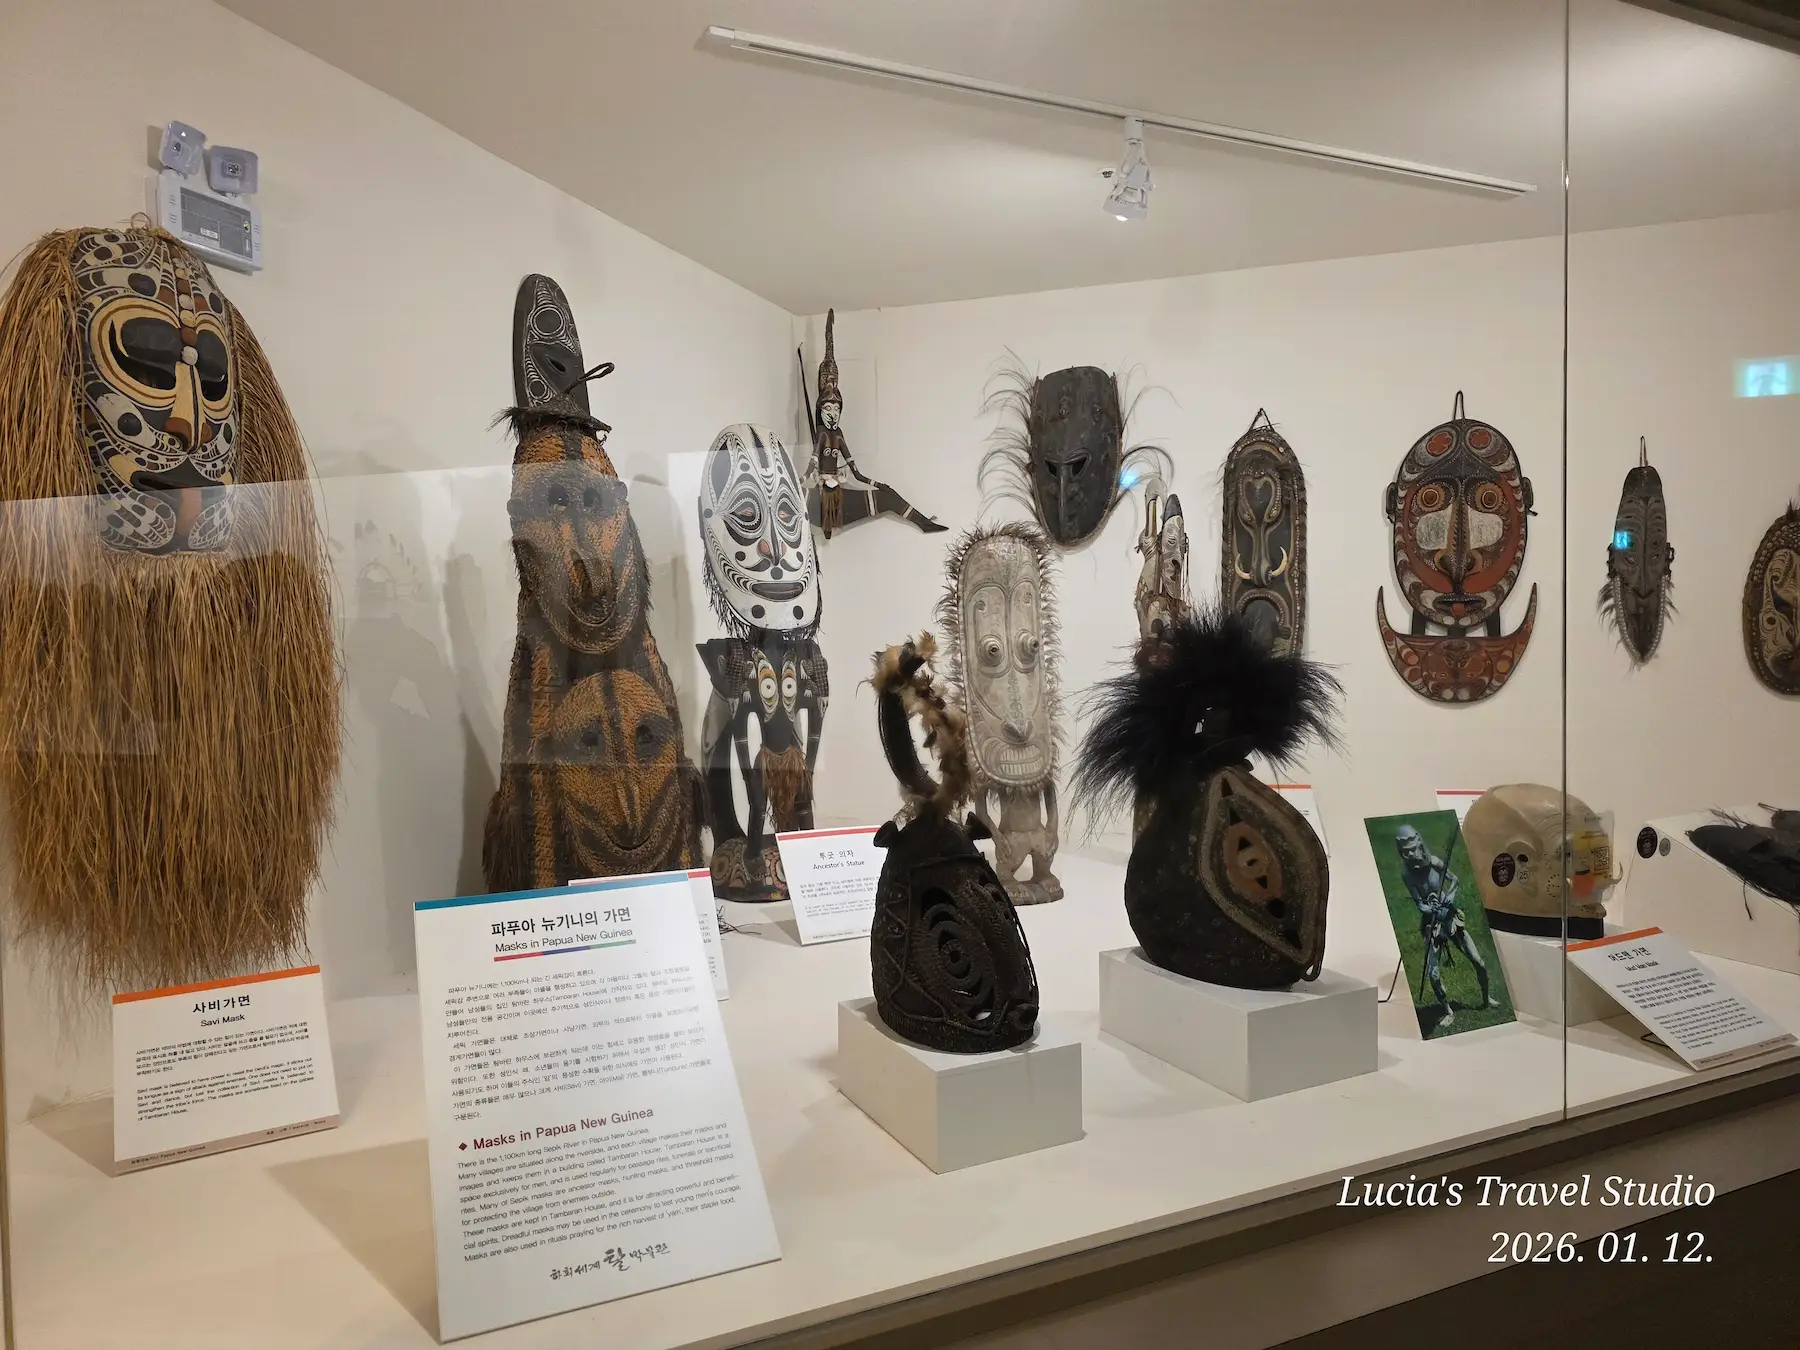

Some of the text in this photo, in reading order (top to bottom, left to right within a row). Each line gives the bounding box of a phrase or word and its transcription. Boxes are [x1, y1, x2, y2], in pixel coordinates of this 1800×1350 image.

[812, 860, 844, 869] Ancestor's
[839, 850, 854, 858] 의자
[490, 906, 631, 936] 파푸아 뉴기니의 가면
[495, 928, 633, 952] Masks in Papua New Guinea
[1631, 946, 1651, 956] 가면
[192, 994, 250, 1013] 사비가면
[200, 1013, 245, 1027] Savi Mask
[473, 1108, 653, 1150] Masks in Papua New Guinea
[457, 1160, 477, 1168] There
[542, 1143, 562, 1152] Sepik
[562, 1140, 579, 1149] River
[588, 1135, 610, 1144] Papua
[610, 1132, 625, 1140] New
[457, 1172, 477, 1180] Many
[478, 1166, 504, 1176] villages
[517, 1157, 544, 1168] situated
[544, 1155, 563, 1163] along
[606, 1143, 619, 1151] and
[620, 1139, 636, 1148] each
[637, 1136, 657, 1144] village
[679, 1128, 693, 1136] their
[694, 1125, 714, 1133] masks
[458, 1182, 484, 1191] images
[501, 1174, 523, 1183] keeps
[524, 1170, 542, 1178] them
[558, 1162, 584, 1172] building
[586, 1156, 605, 1166] called
[606, 1151, 639, 1162] Tambaran
[663, 1139, 695, 1150] Tambaran
[696, 1135, 717, 1143] House
[459, 1193, 481, 1203] space
[482, 1185, 519, 1198] exclusively
[549, 1176, 563, 1185] and
[571, 1171, 588, 1180] used
[589, 1166, 617, 1176] regularly
[627, 1159, 655, 1170] passage
[479, 1202, 498, 1210] Many
[509, 1195, 529, 1204] Sepik
[530, 1191, 553, 1200] masks
[567, 1181, 595, 1192] ancestor
[713, 1152, 734, 1161] masks
[462, 1228, 484, 1237] These
[486, 1223, 509, 1233] masks
[523, 1215, 539, 1224] kept
[548, 1207, 583, 1219] Tambaran
[608, 1198, 622, 1207] and
[674, 1180, 701, 1193] powerful
[702, 1178, 715, 1186] and
[472, 1211, 507, 1225] protecting
[521, 1204, 543, 1213] village
[544, 1200, 561, 1208] from
[561, 1194, 590, 1205] enemies
[501, 1229, 531, 1242] Dreadful
[531, 1225, 555, 1235] masks
[555, 1221, 570, 1229] may
[582, 1214, 599, 1224] used
[620, 1203, 652, 1216] ceremony
[674, 1195, 694, 1204] young
[695, 1188, 714, 1200] men's
[463, 1251, 488, 1261] Masks
[503, 1245, 519, 1253] also
[519, 1239, 537, 1250] used
[547, 1233, 567, 1244] rituals
[568, 1228, 594, 1240] praying
[632, 1213, 657, 1224] harvest
[684, 1204, 699, 1212] their
[699, 1200, 719, 1209] staple
